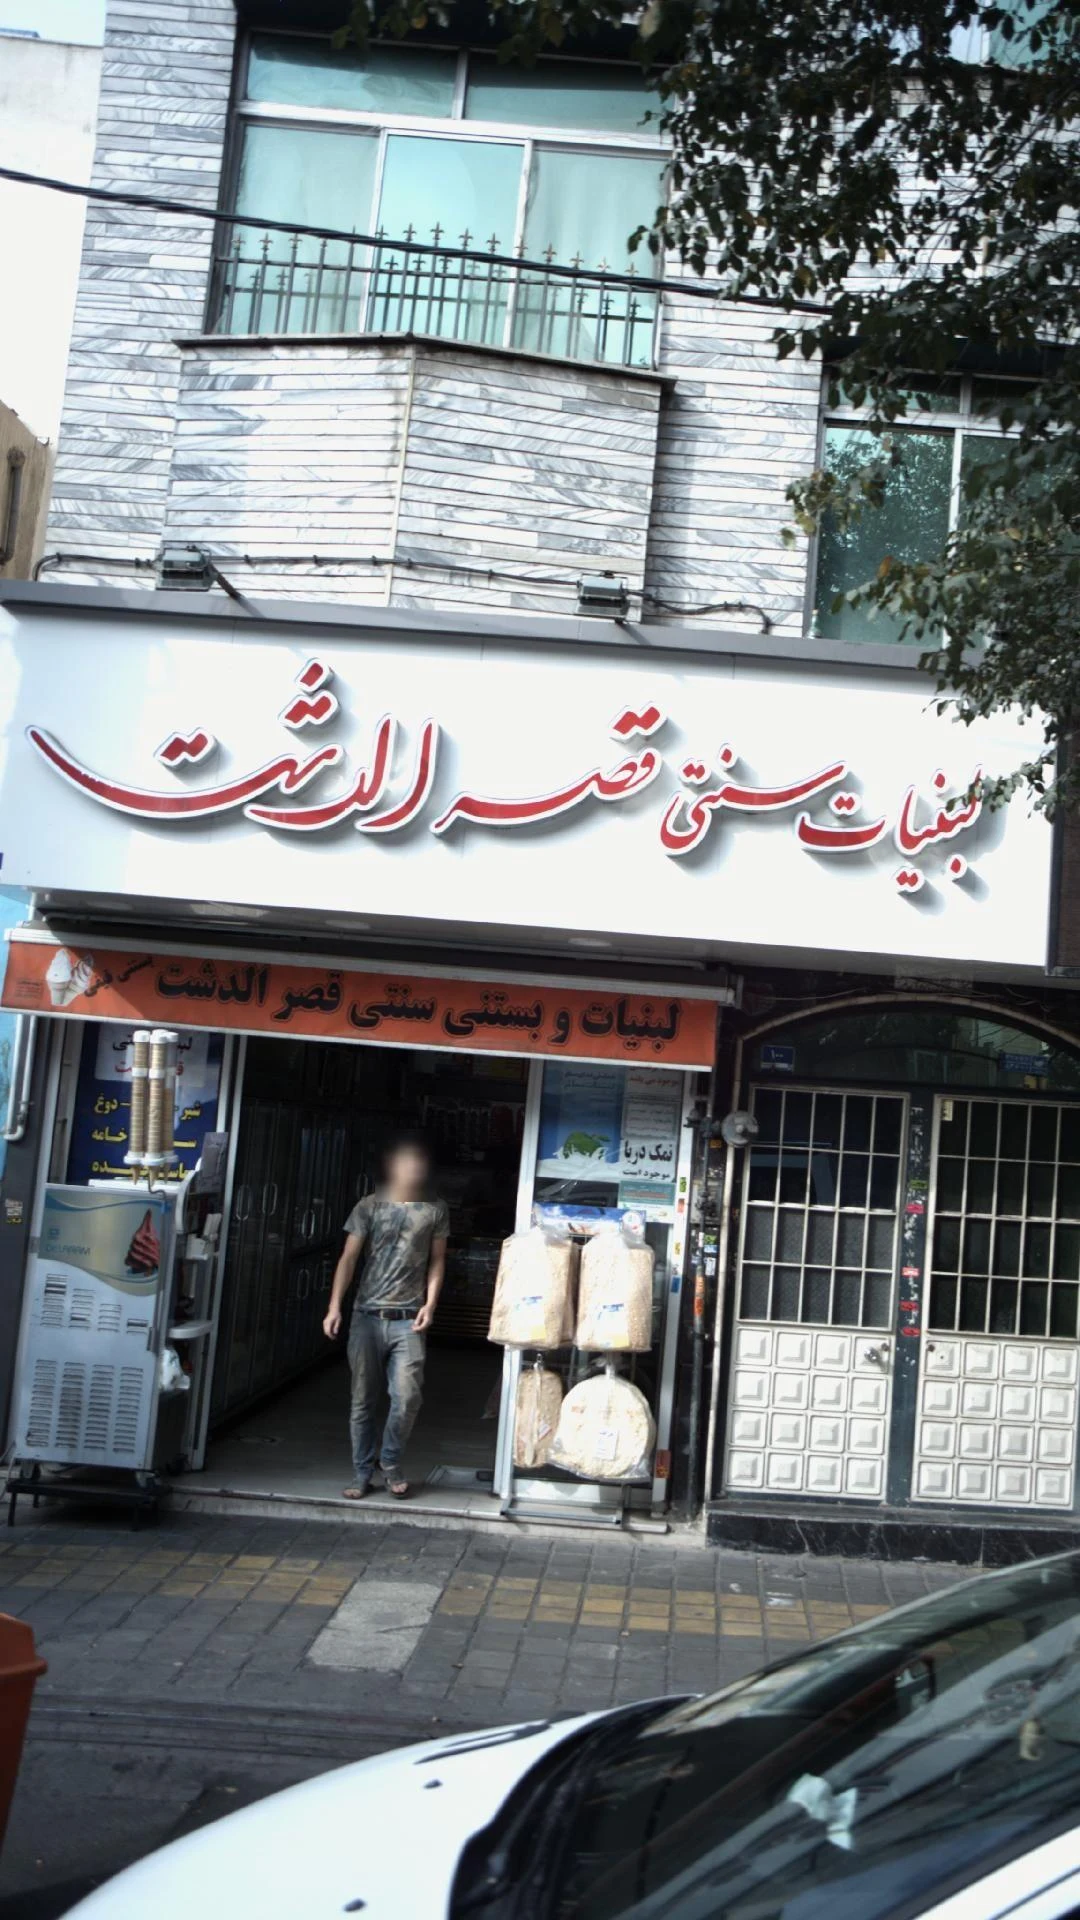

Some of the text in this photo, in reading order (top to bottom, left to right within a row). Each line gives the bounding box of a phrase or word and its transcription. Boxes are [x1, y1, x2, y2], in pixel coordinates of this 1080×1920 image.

[659, 744, 848, 854] سنتی
[156, 960, 683, 1052] لبنیات و بستنی سنتی قصر الدشت
[94, 1093, 118, 1115] دوغ
[91, 1126, 128, 1143] خامه
[624, 1140, 674, 1165] نمک دریا
